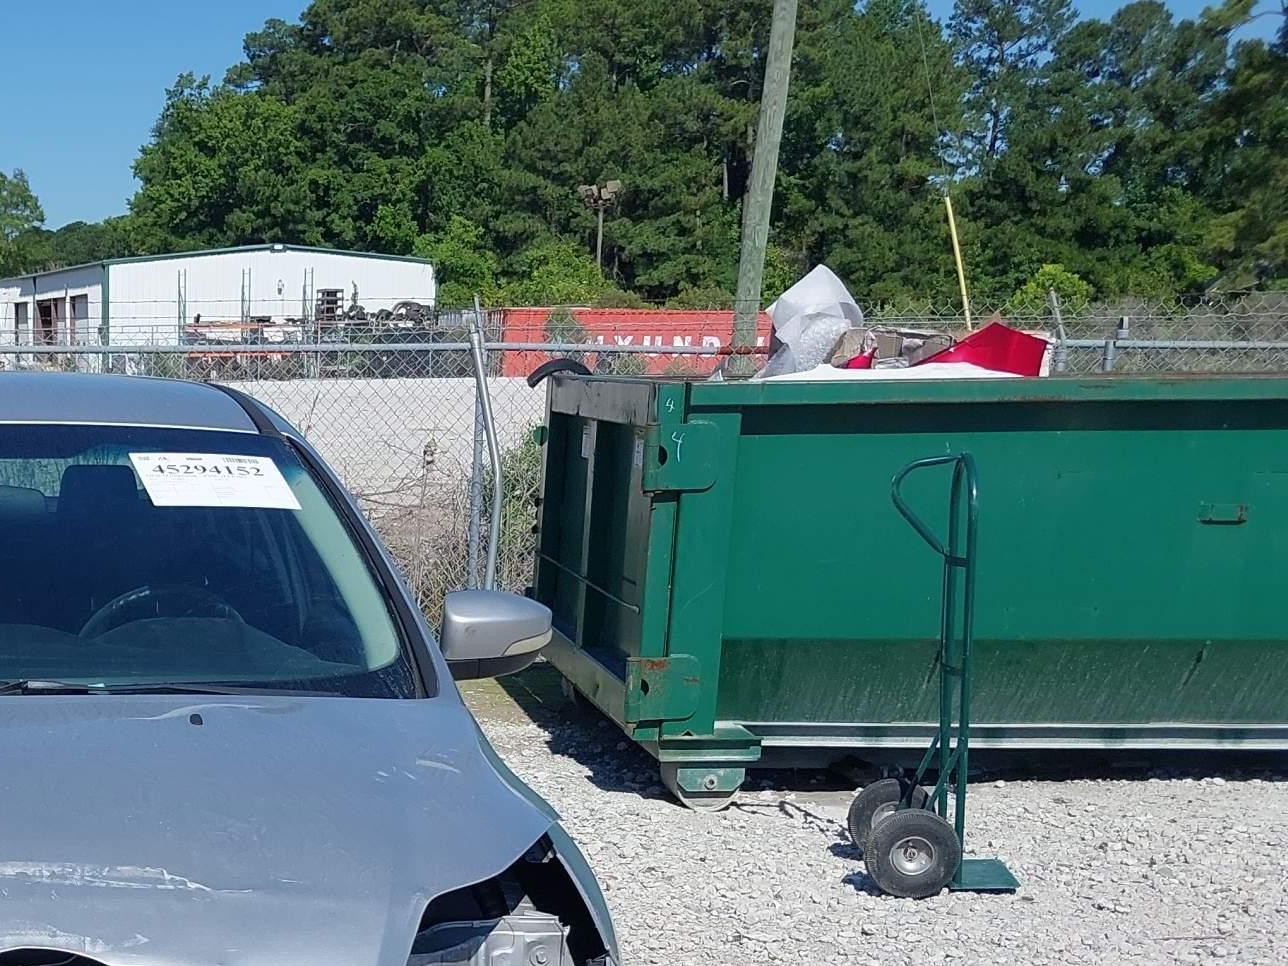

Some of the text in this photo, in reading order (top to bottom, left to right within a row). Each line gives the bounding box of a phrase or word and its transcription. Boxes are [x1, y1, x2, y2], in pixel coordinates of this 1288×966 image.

[585, 335, 766, 358] YUNDI
[671, 431, 686, 463] 4
[152, 464, 264, 476] 45294152
